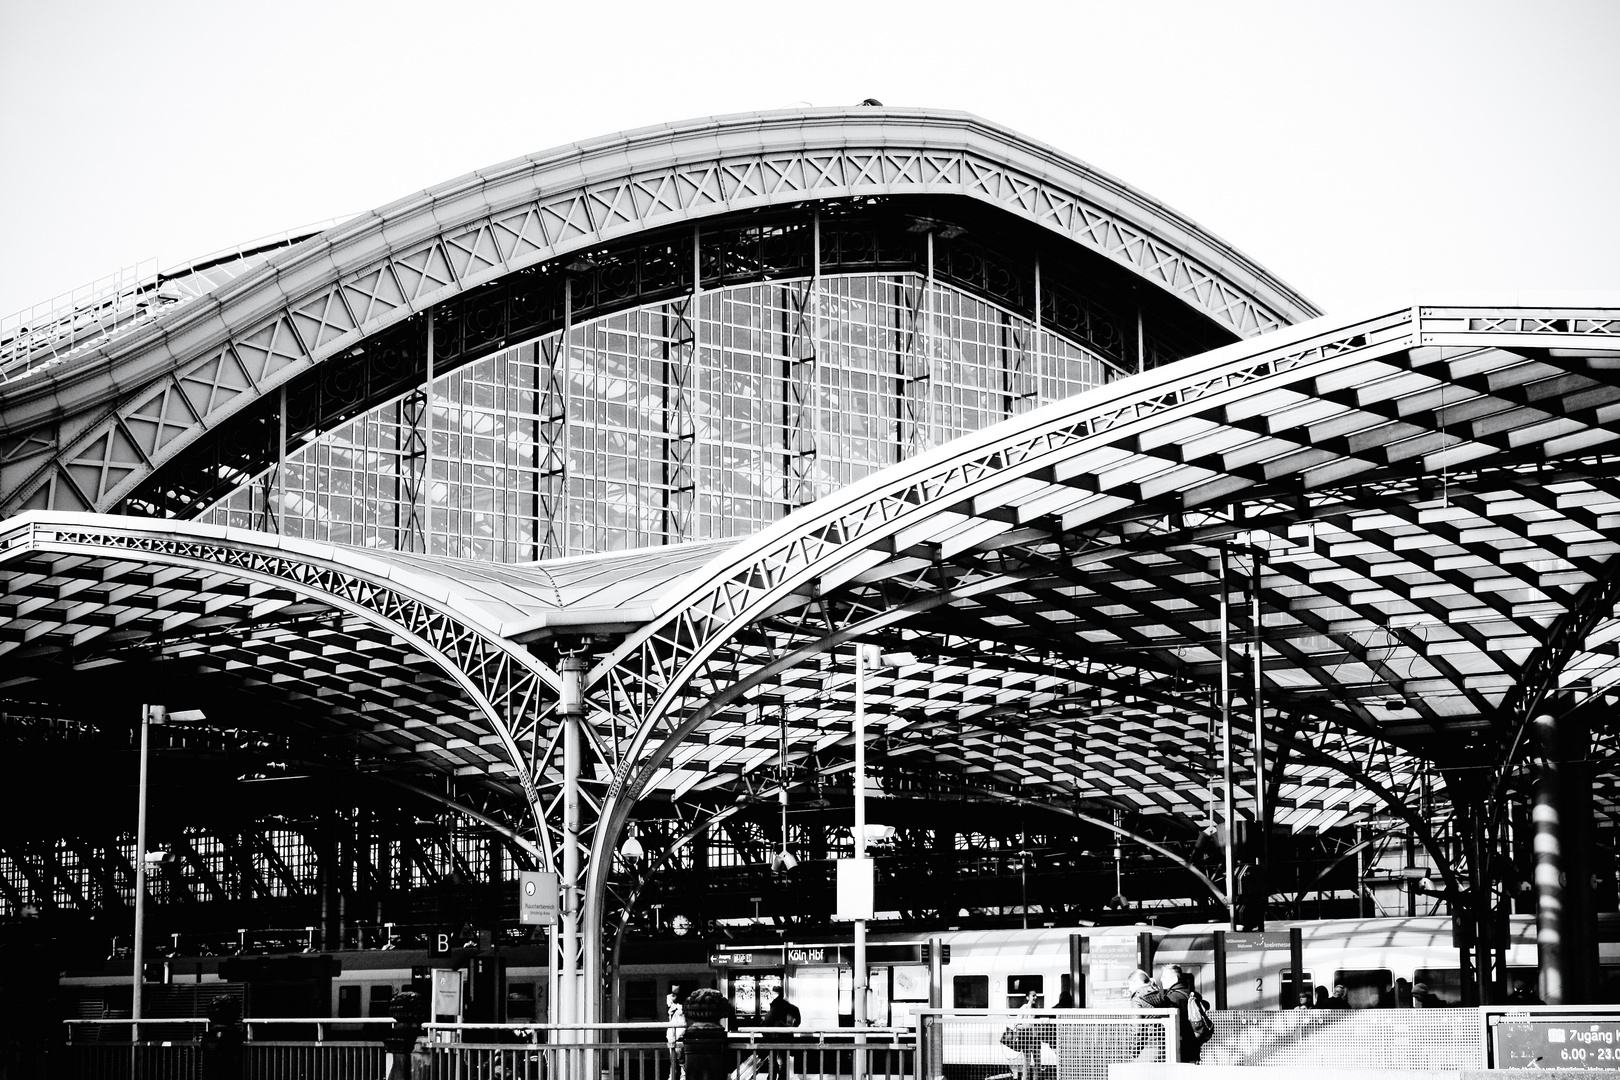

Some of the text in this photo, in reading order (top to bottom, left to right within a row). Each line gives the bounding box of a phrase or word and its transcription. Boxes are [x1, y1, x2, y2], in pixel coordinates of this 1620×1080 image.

[708, 920, 714, 933] 5
[438, 934, 448, 952] B
[788, 949, 824, 961] Köln Hbf
[1256, 978, 1262, 991] 2
[1561, 1048, 1586, 1060] 6.00
